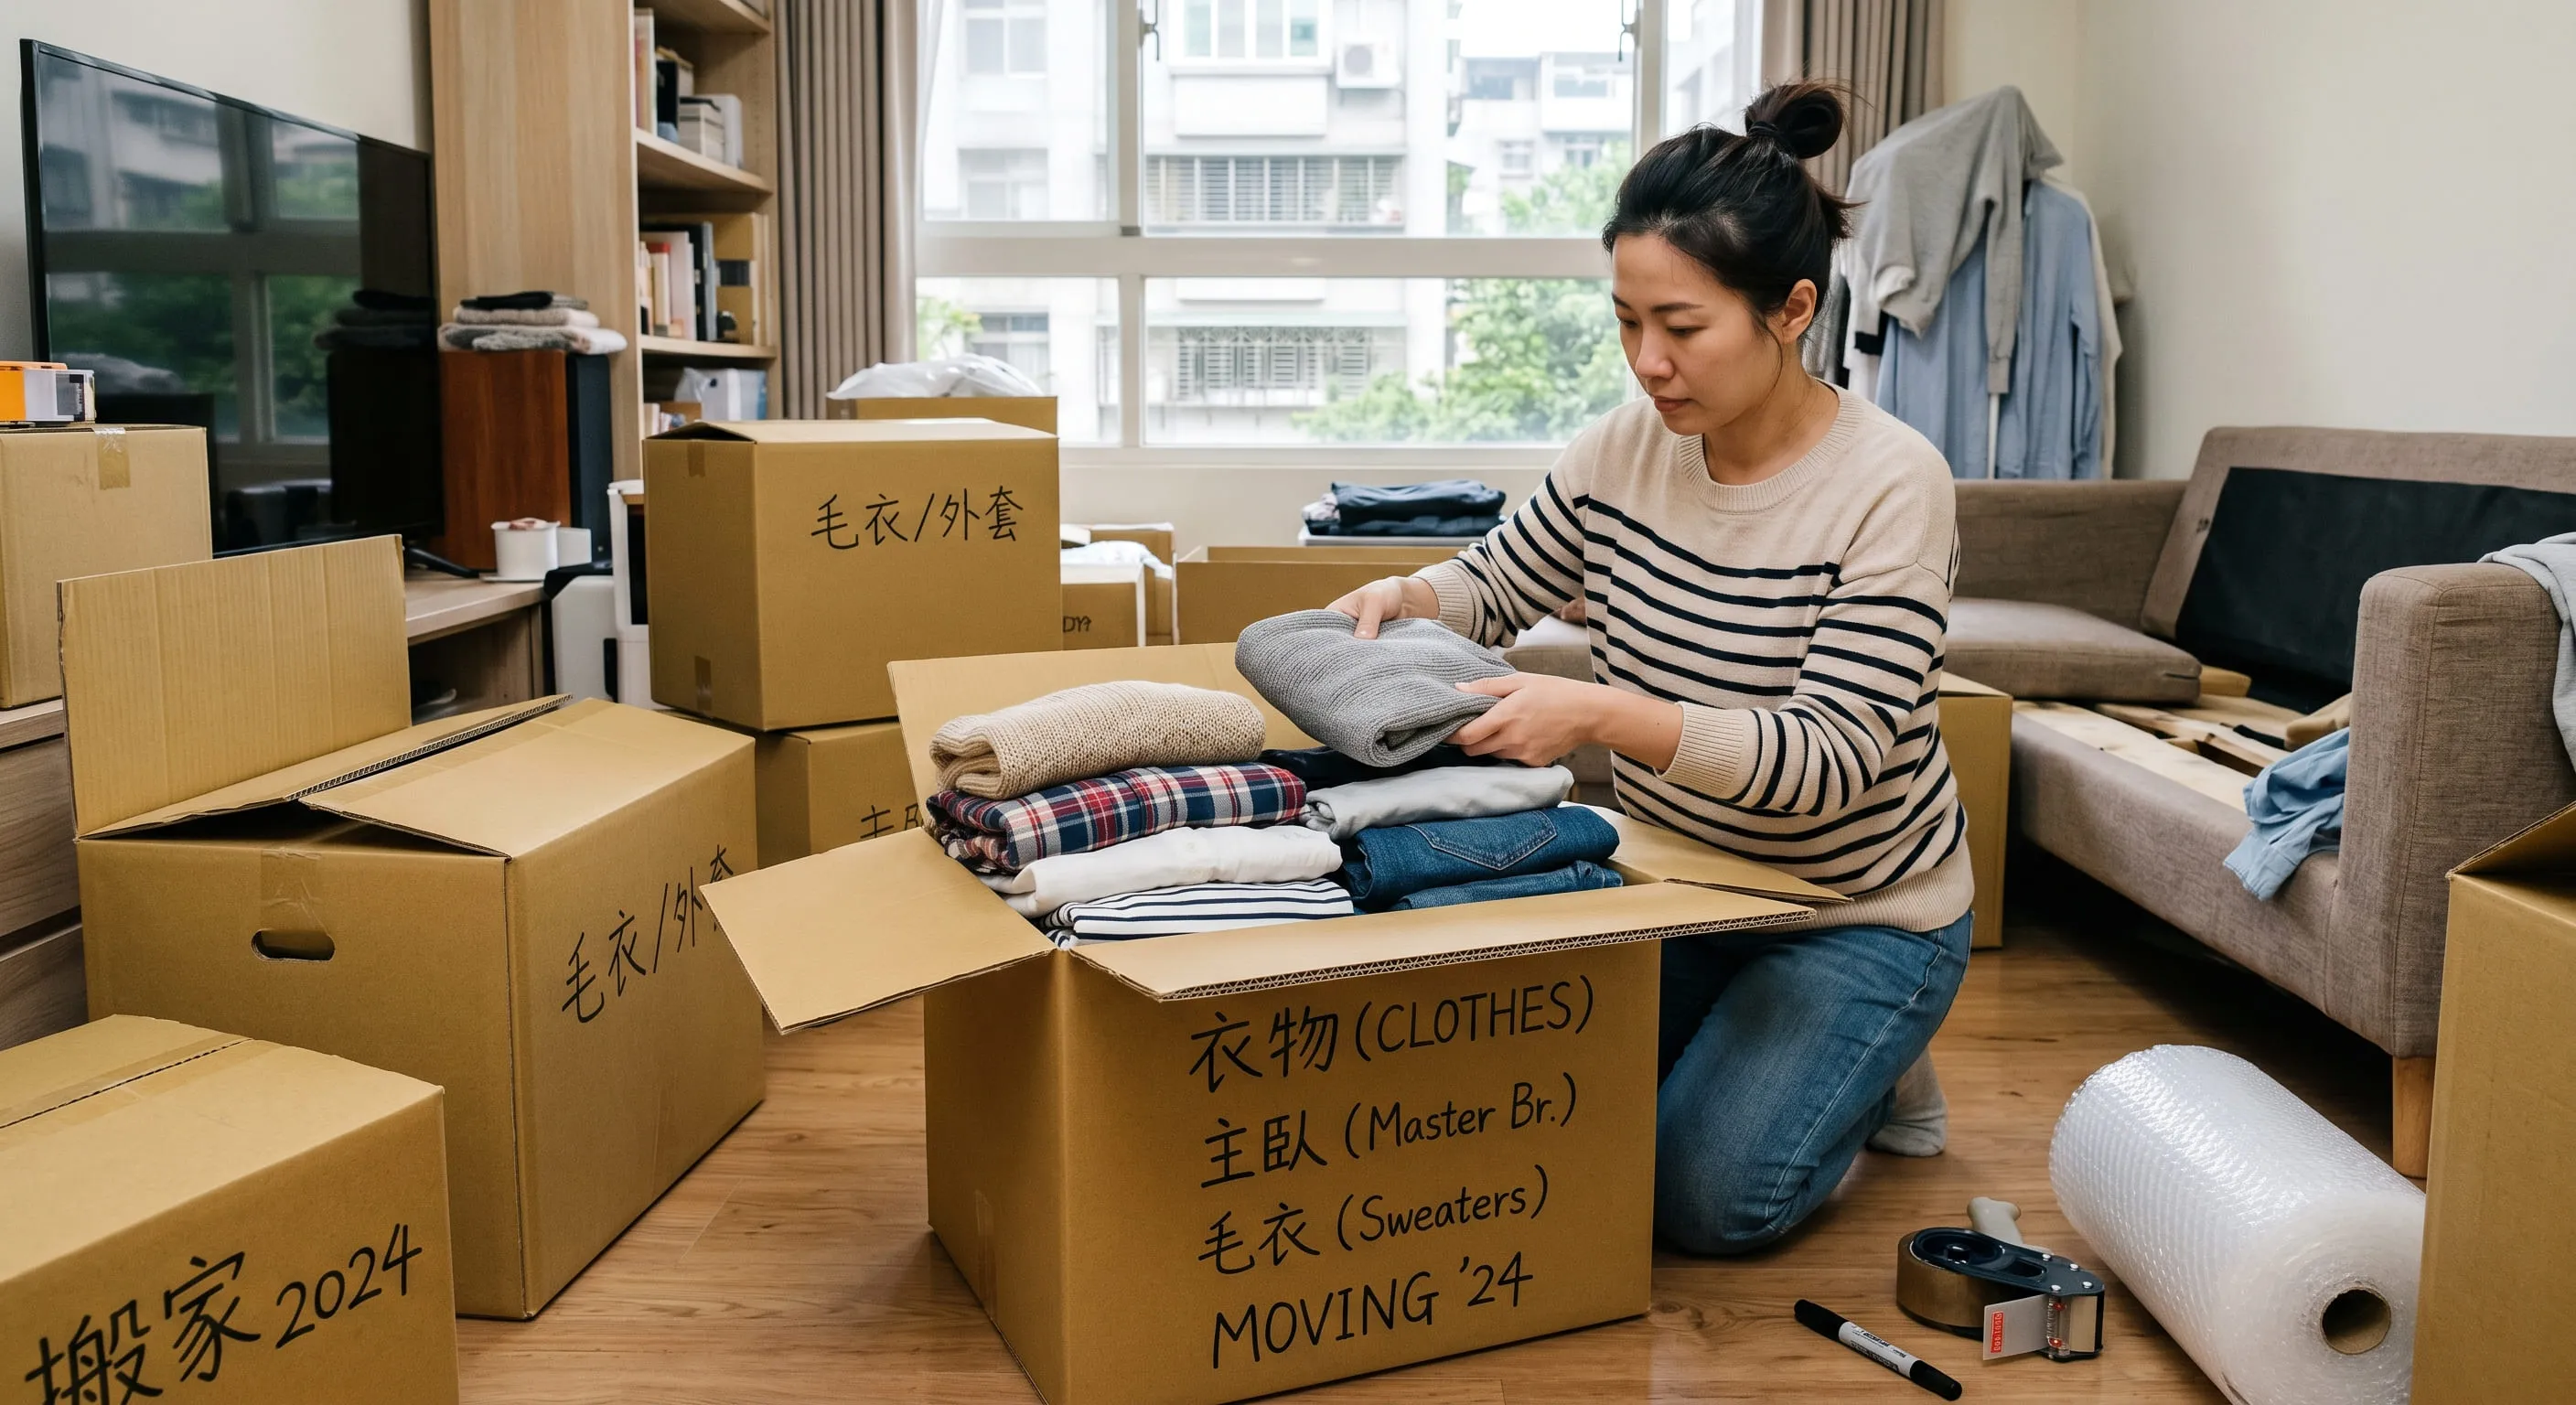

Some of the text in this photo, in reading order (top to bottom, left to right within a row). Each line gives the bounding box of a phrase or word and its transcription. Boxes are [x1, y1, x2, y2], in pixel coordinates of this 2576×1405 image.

[810, 485, 1025, 550] 毛衣/外套
[1188, 974, 1594, 1094] 衣物 (CLOTHES)
[1200, 1071, 1577, 1189] 主臥 (Master Br.)
[1197, 1164, 1549, 1275] 毛衣 (Sweaters)
[25, 1222, 423, 1405] 搬家 2024
[1212, 1271, 1440, 1370] MOVING
